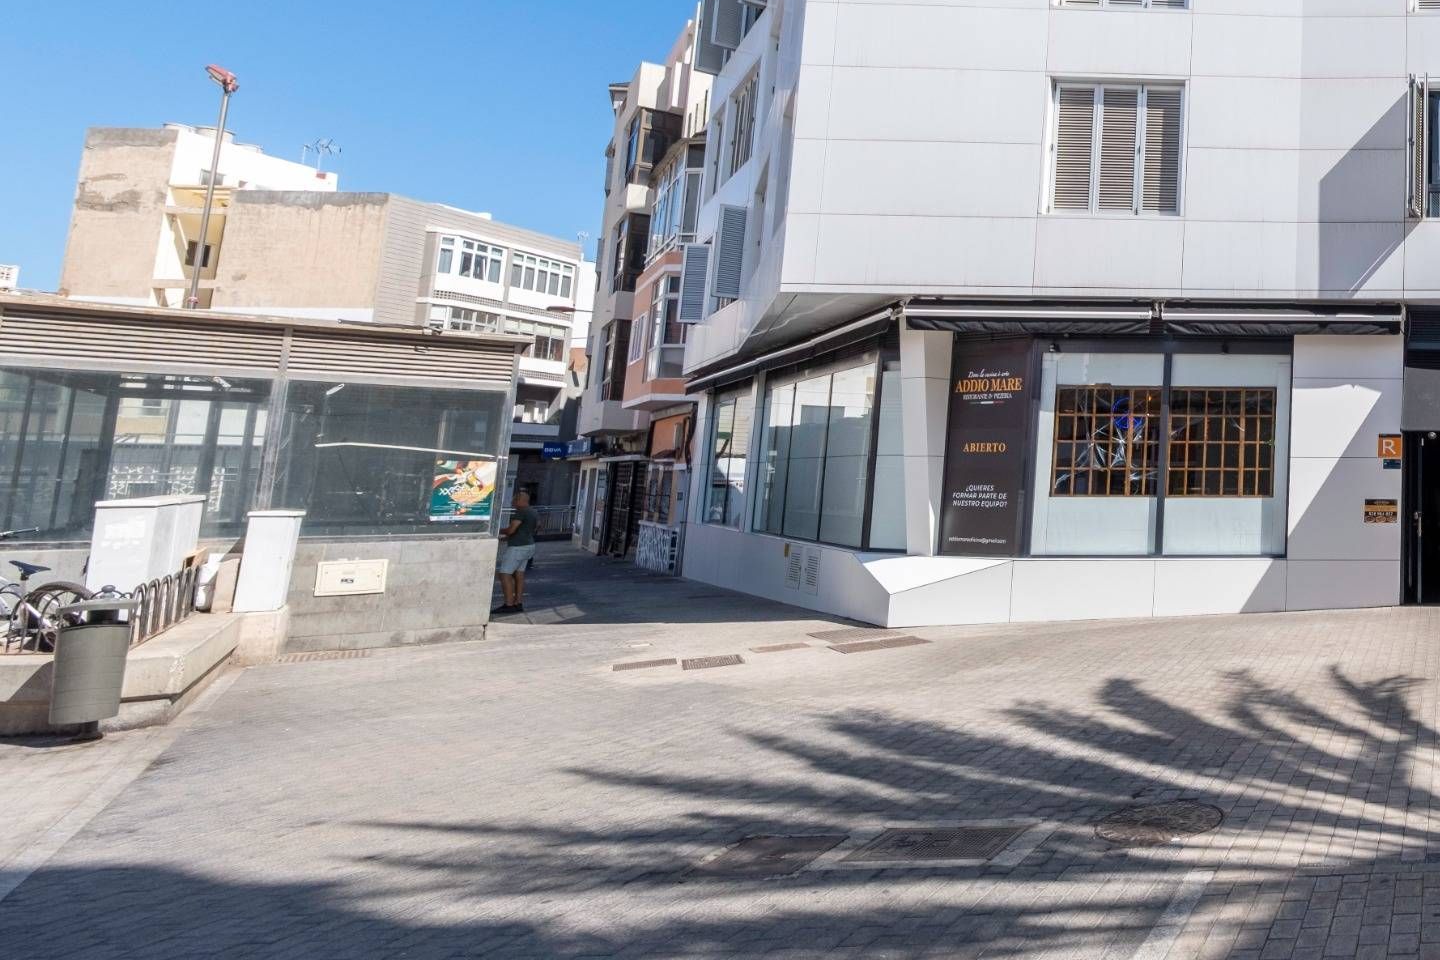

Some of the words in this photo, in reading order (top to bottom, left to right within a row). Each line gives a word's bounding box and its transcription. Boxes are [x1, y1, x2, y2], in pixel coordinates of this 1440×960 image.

[956, 379, 989, 392] ADDIO
[991, 378, 1022, 391] MARE
[963, 443, 1006, 452] ABIERTO
[1382, 439, 1396, 454] R
[966, 484, 994, 492] ¿QUIERES
[981, 500, 1008, 508] EQUIPO?
